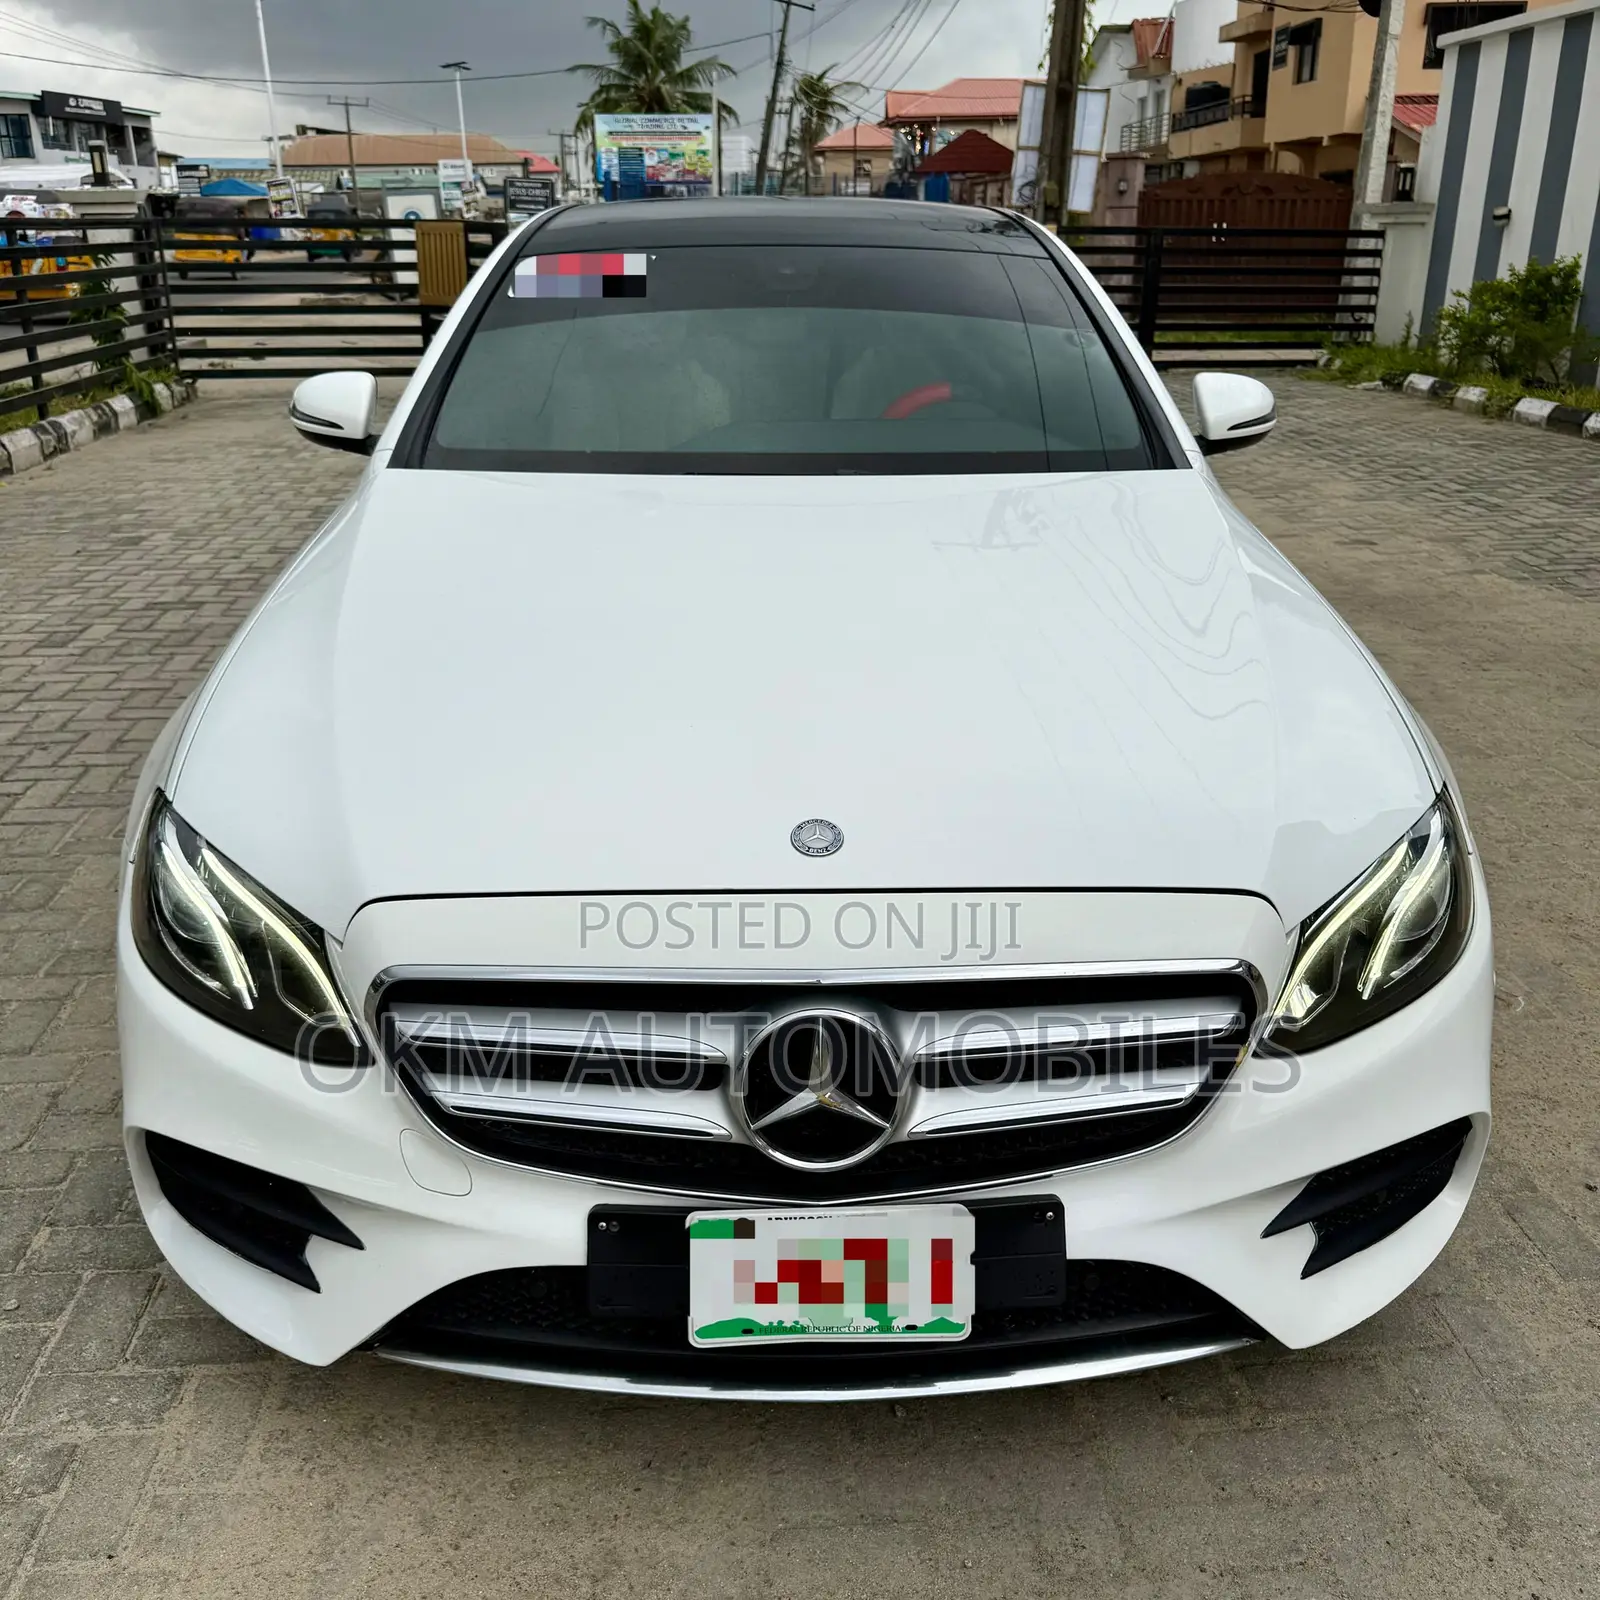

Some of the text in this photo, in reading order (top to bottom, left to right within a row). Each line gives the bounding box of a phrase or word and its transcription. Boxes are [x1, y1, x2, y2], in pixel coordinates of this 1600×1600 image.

[759, 1325, 798, 1334] FEDERAL
[801, 1325, 846, 1333] REPUBLIC
[863, 1324, 903, 1332] NIGERIA
